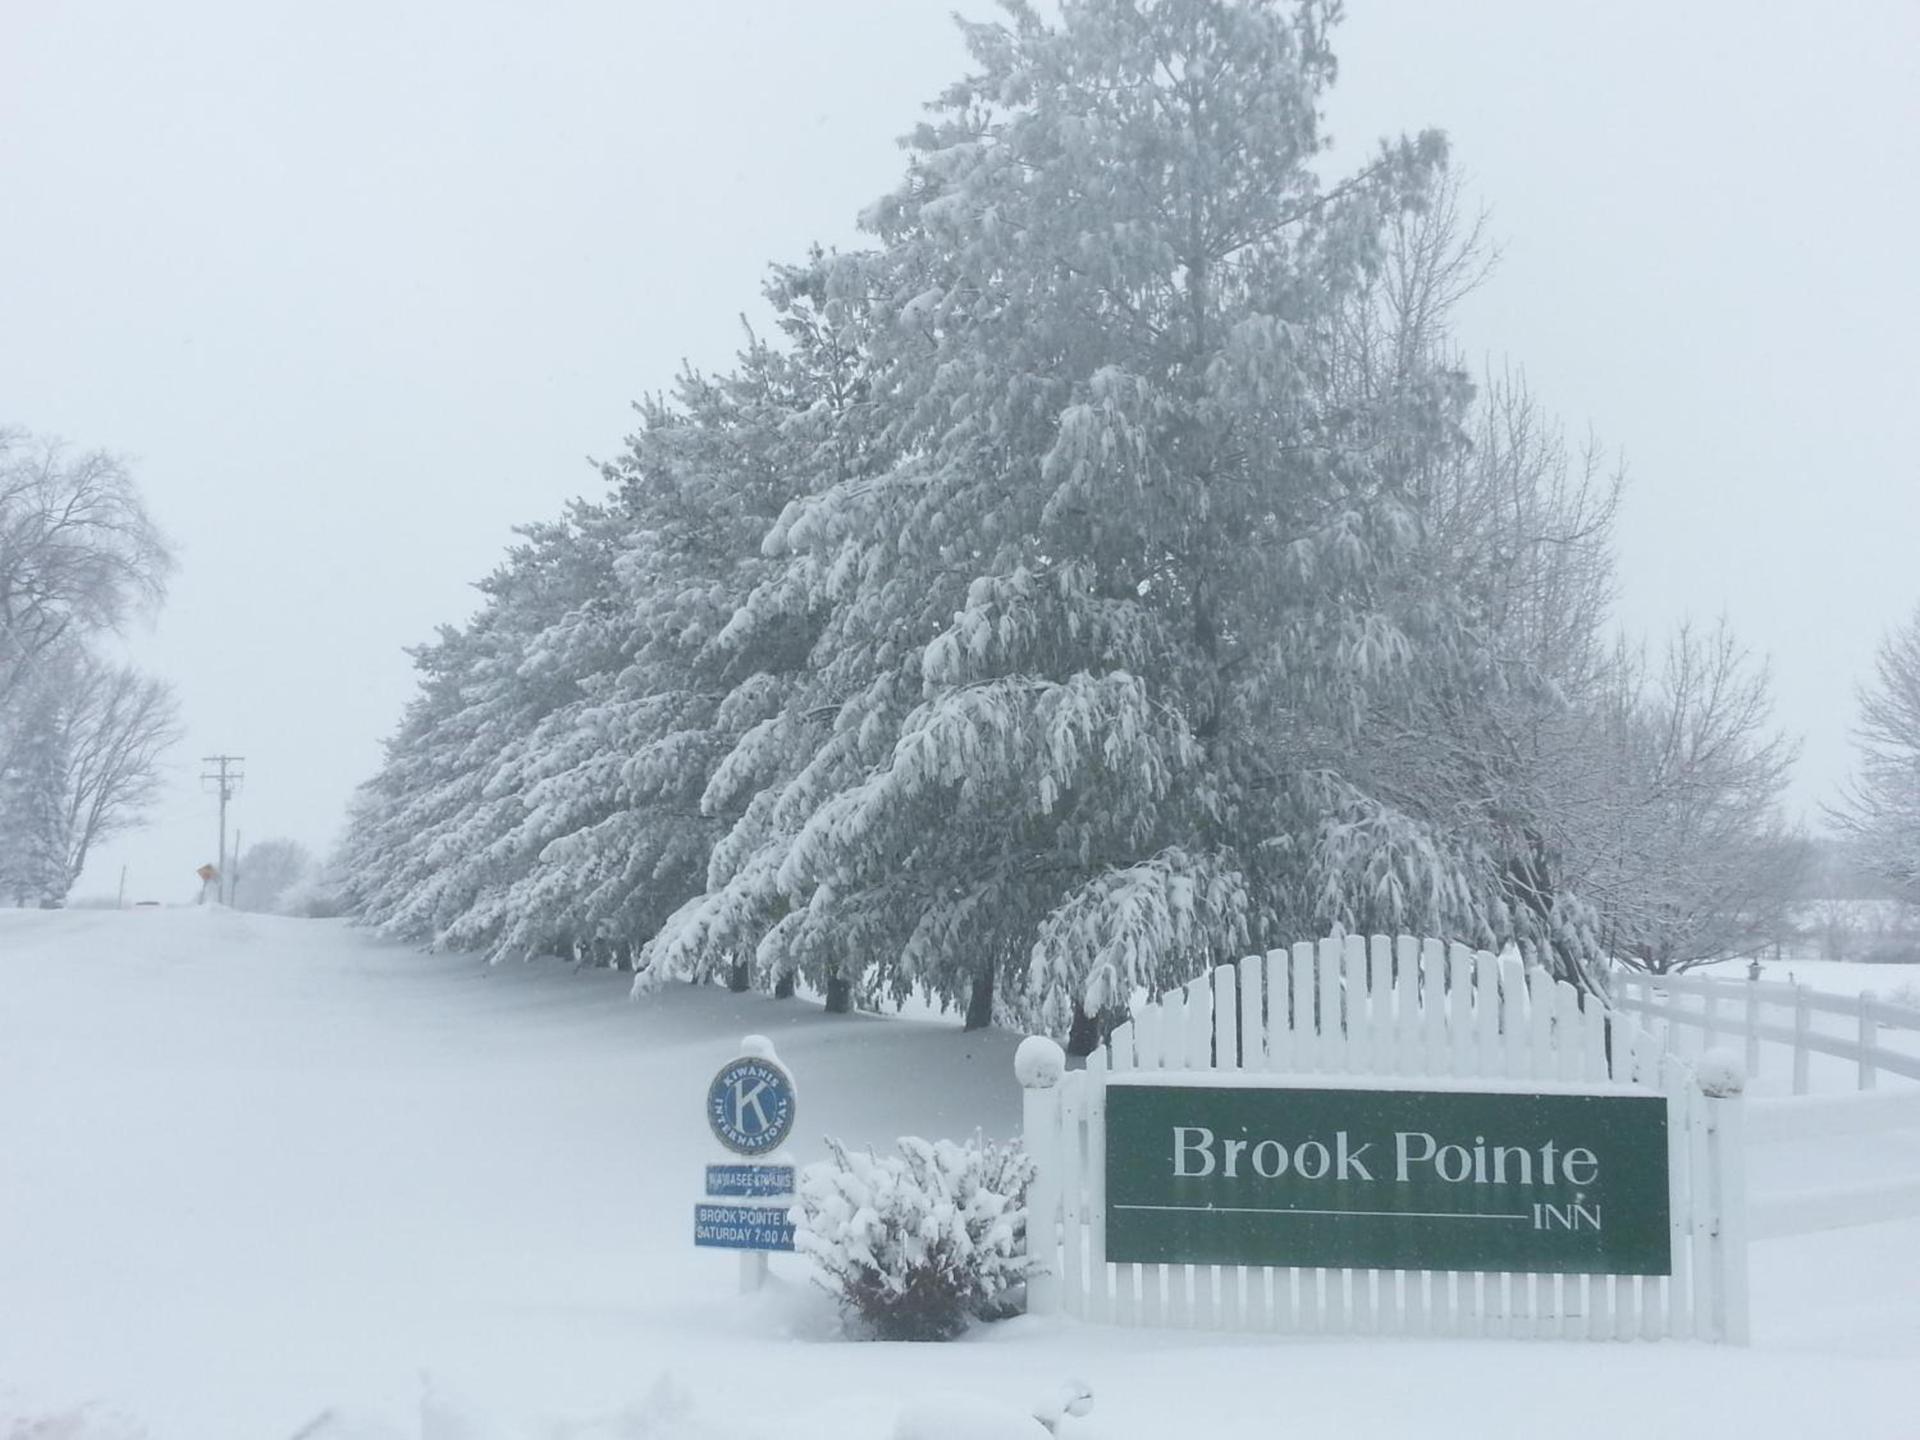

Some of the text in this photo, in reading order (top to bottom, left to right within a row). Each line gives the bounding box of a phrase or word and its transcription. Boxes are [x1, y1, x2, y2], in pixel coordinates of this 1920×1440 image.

[724, 1066, 779, 1088] KIWANIS
[734, 1079, 770, 1134] K
[715, 1098, 787, 1146] INTERNATIONAL
[1172, 1126, 1599, 1185] Brook Pointe
[700, 1208, 737, 1224] BROOK
[739, 1210, 780, 1226] POINTE
[1532, 1202, 1601, 1231] INN
[696, 1225, 752, 1241] SATURDAY
[755, 1228, 778, 1244] 7:00
